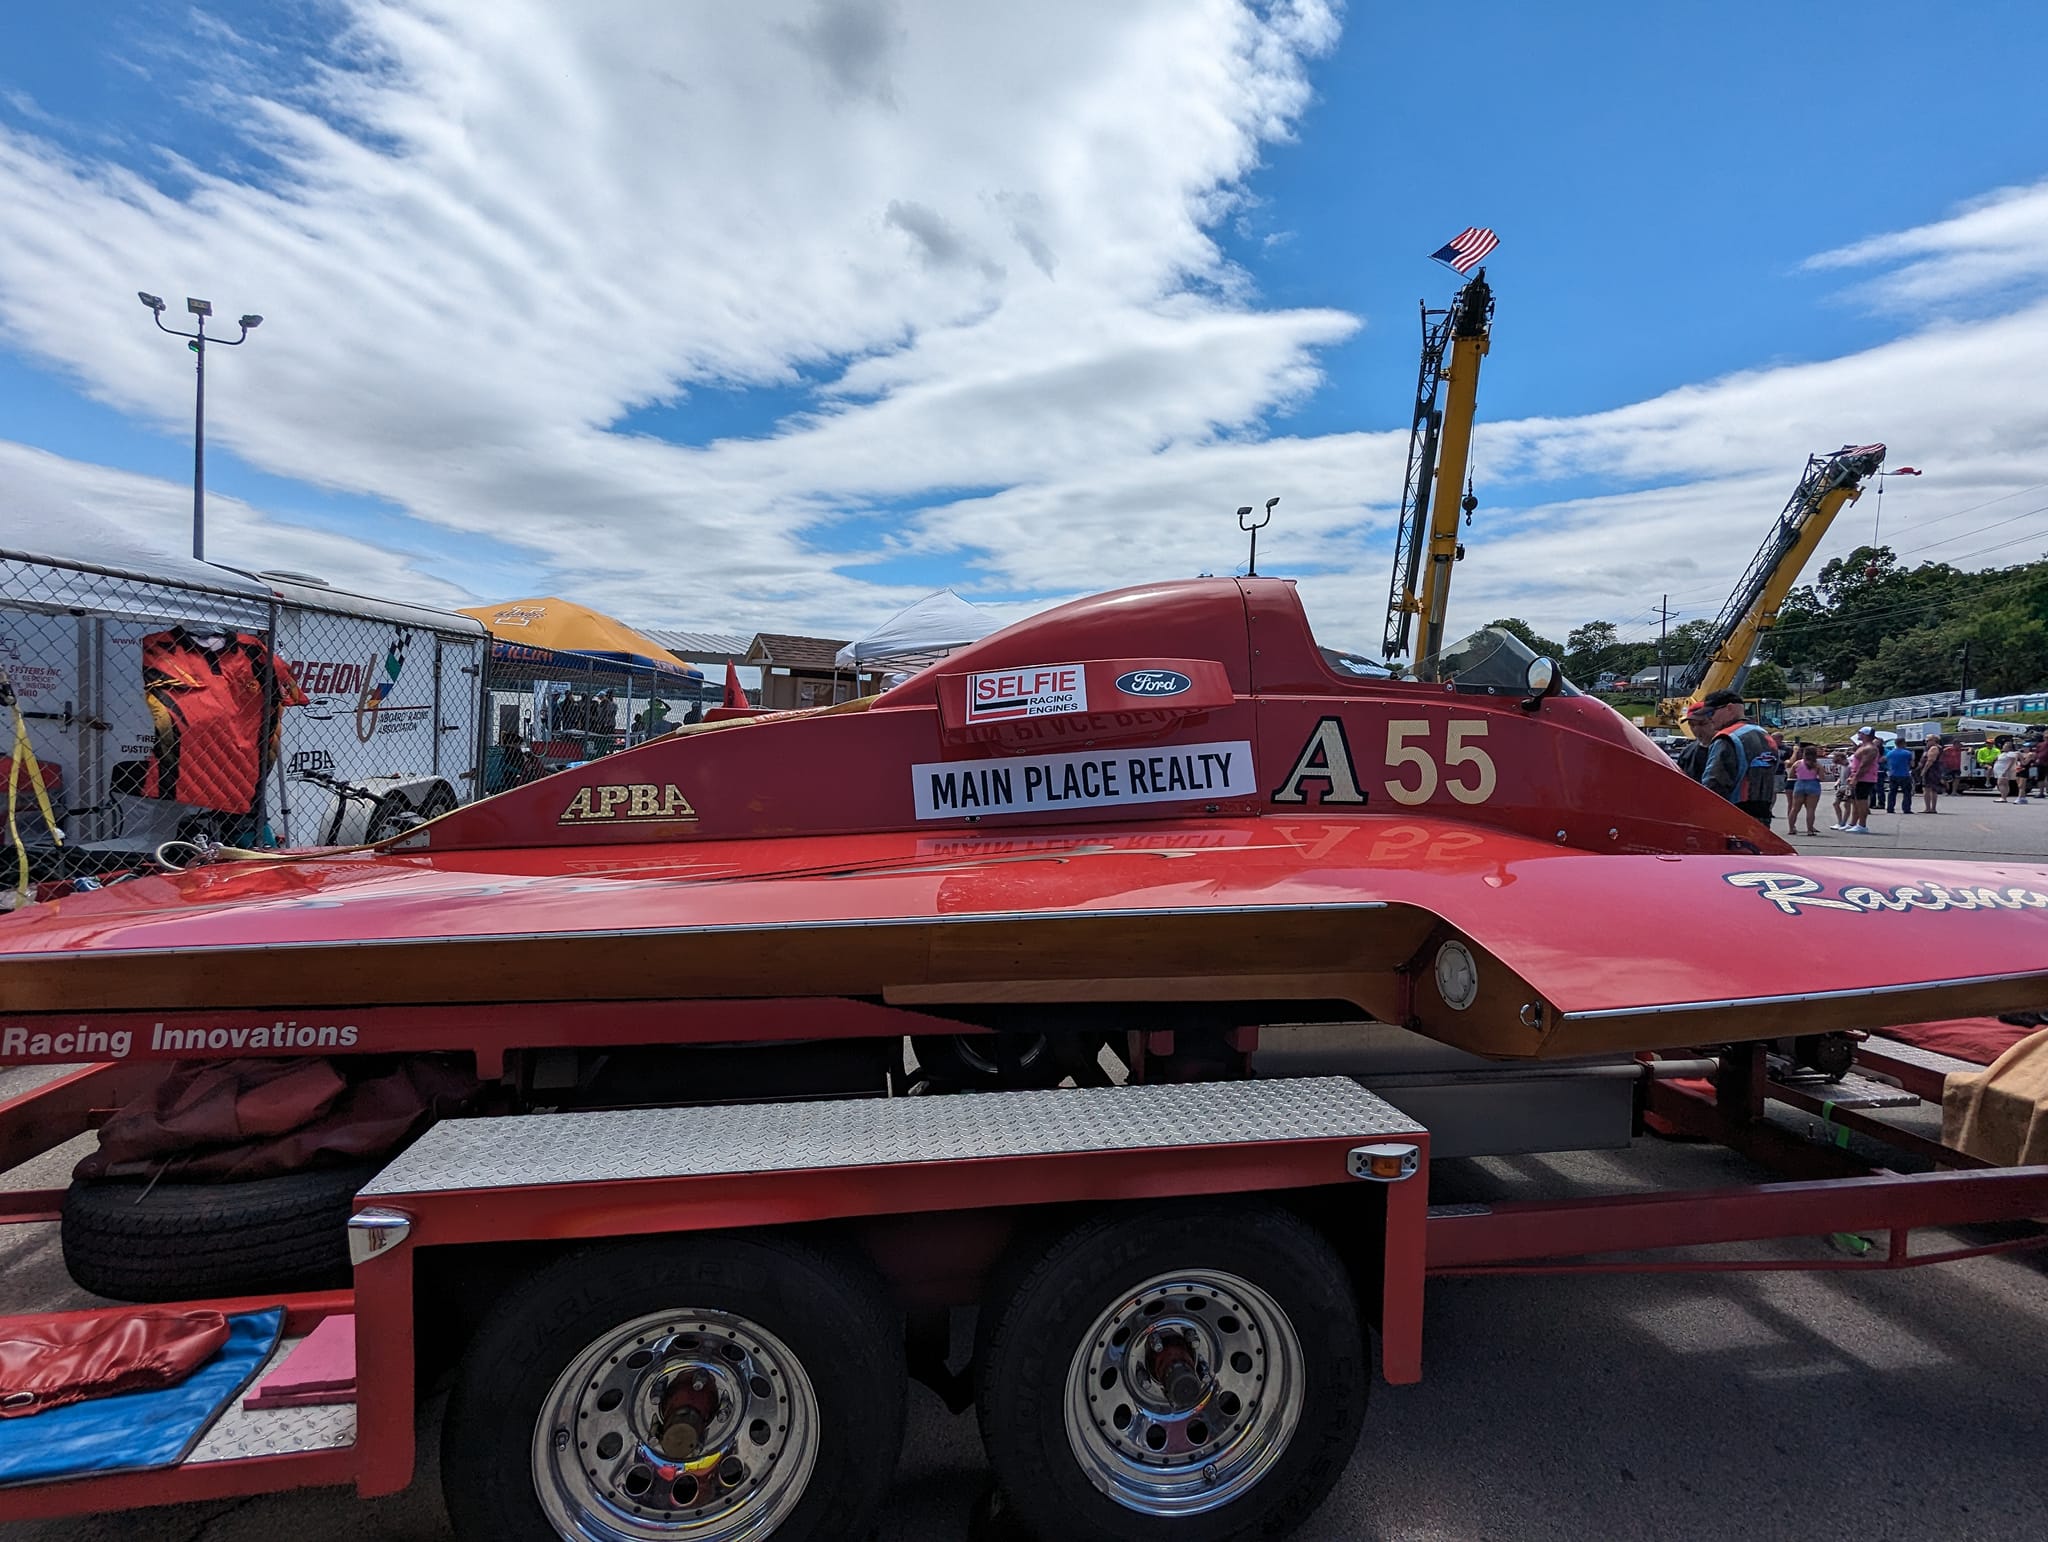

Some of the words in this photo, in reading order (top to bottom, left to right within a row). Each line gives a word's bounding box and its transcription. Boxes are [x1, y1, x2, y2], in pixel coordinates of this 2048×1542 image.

[977, 670, 1077, 700] SELFIE
[1131, 673, 1177, 693] Ford
[1028, 703, 1078, 715] ENGINES
[1029, 694, 1073, 706] RACING
[121, 745, 152, 753] CUSTO
[286, 750, 336, 774] APBA
[1272, 715, 1369, 806] A
[1384, 719, 1498, 806] 55
[931, 765, 1013, 810] MAIN
[1024, 760, 1119, 803] PLACE
[1129, 752, 1235, 797] REALTY
[559, 783, 696, 819] APBA
[1, 1026, 132, 1057] Racing
[150, 1020, 359, 1051] Innovations
